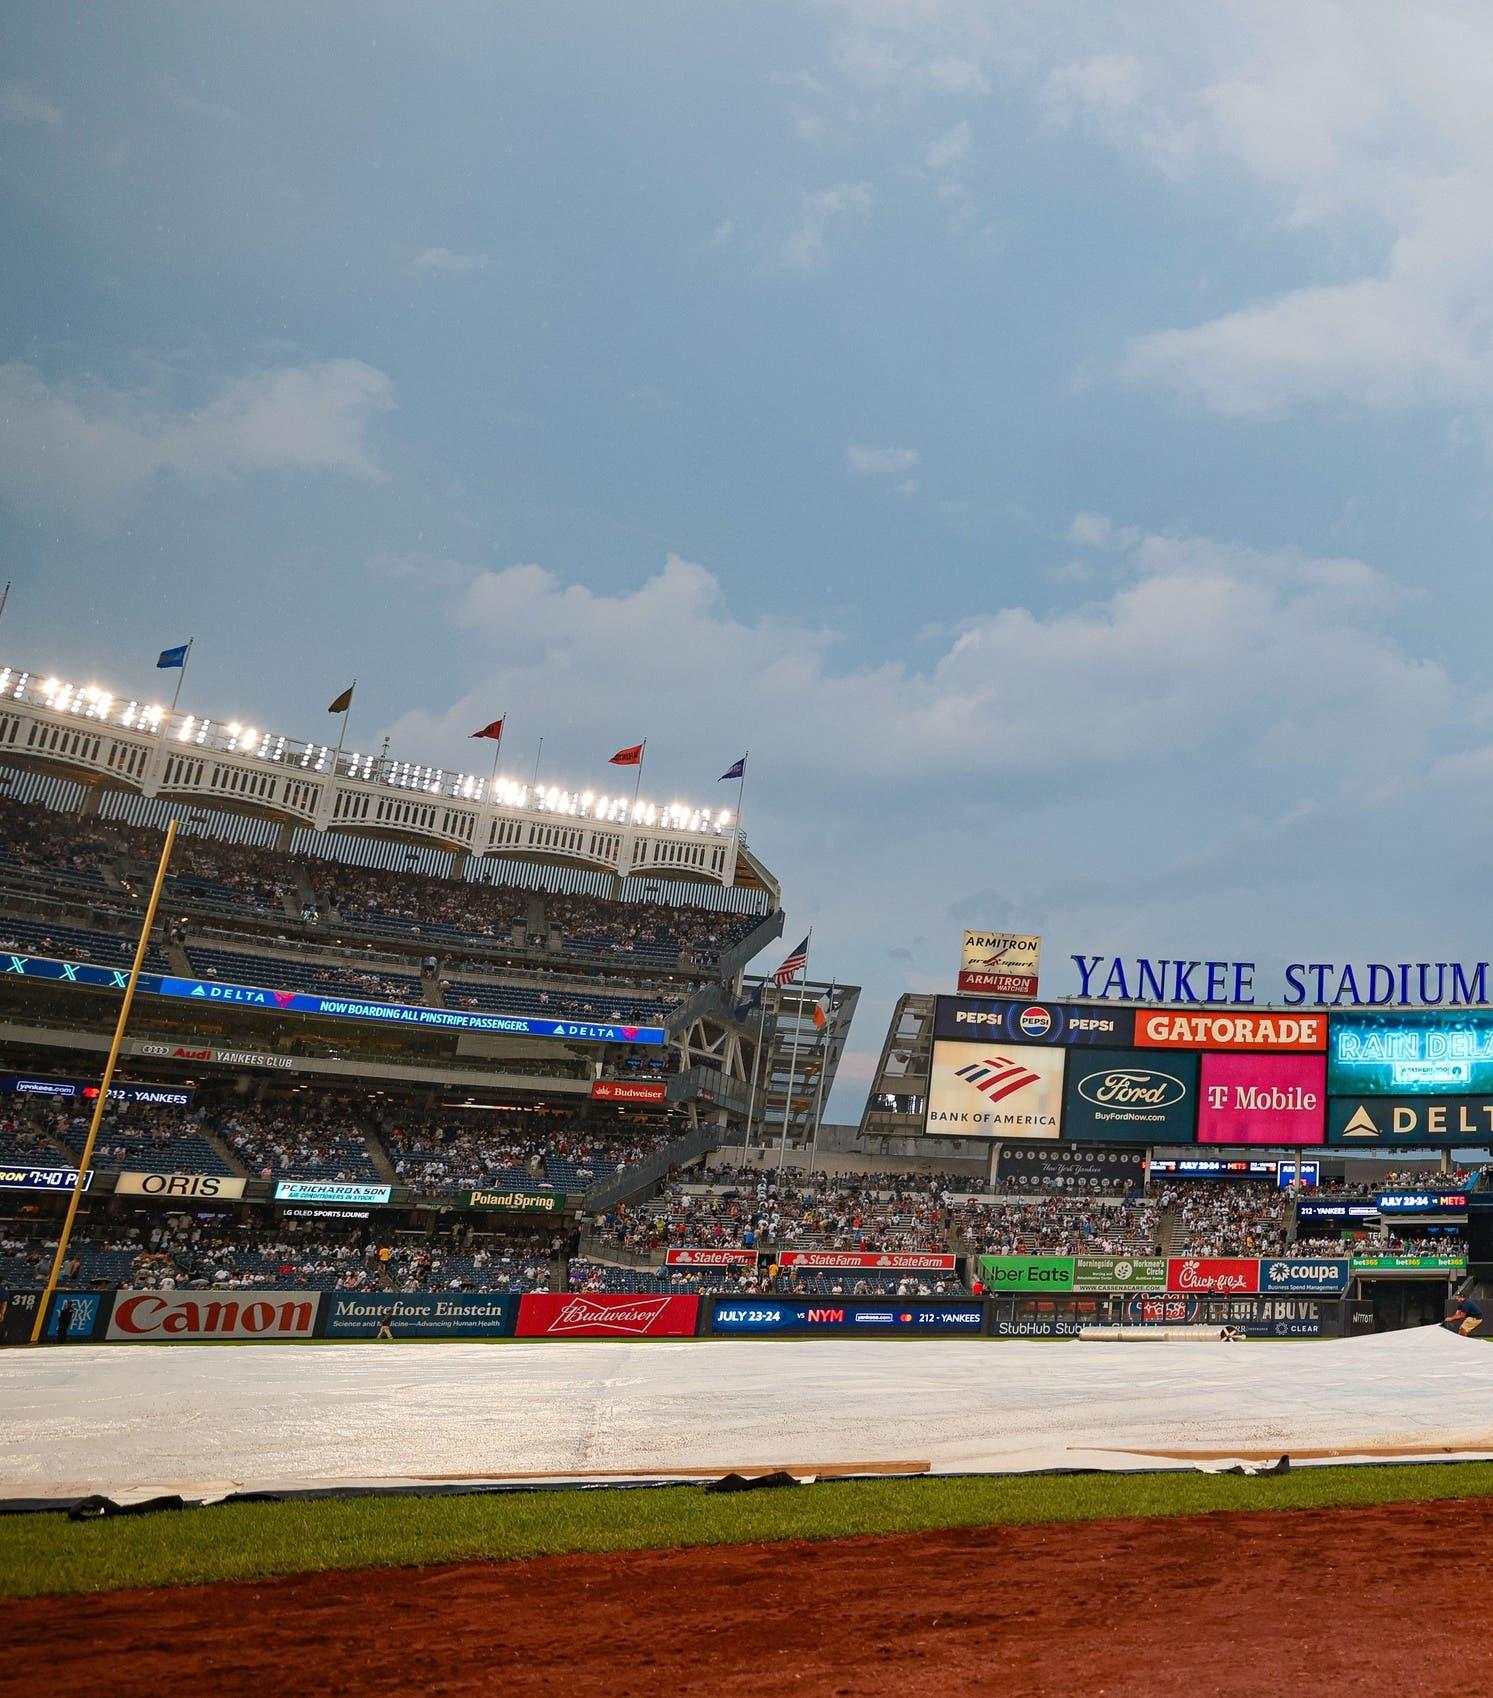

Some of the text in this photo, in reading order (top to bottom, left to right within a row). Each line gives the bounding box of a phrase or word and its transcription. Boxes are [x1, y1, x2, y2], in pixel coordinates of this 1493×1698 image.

[966, 936, 1037, 951] ARMITRON
[966, 974, 1031, 987] ARMITRON
[1070, 954, 1490, 1006] YANKEE STADIUM
[210, 987, 265, 1003] DELTA
[997, 984, 1029, 993] WATCHES
[319, 1001, 530, 1031] NOW BOARDING ALL PINSTRIPE PASSENGERS.
[956, 1011, 1114, 1032] PEPSI PEPSI PEPSI
[569, 1026, 615, 1038] DELTA
[1146, 1016, 1319, 1045] GATORADE
[1337, 1032, 1419, 1060] RAIN
[173, 1048, 293, 1068] Audi YANKEES CLUB
[19, 1083, 72, 1094] yankees.com
[614, 1087, 662, 1098] Budweiser
[1095, 1074, 1167, 1104] Ford
[135, 1092, 188, 1104] YANKEES
[1236, 1086, 1317, 1111] Mobile
[931, 1111, 1057, 1126] BANK OF AMERICA
[1095, 1112, 1166, 1122] BuyFordNow.com
[29, 1171, 63, 1185] 7:40
[142, 1175, 222, 1197] ORIS
[281, 1184, 386, 1196] PC RICHARD & SON
[300, 1192, 344, 1200] CONDITIONERS
[470, 1190, 555, 1210] Poland Spring
[1380, 1196, 1465, 1206] JULY METS
[293, 1209, 313, 1217] OLED
[313, 1210, 342, 1218] SPORTS
[342, 1211, 370, 1219] LOUNGE
[1316, 1207, 1345, 1215] YANKEES
[1027, 1266, 1069, 1282] Eats
[1146, 1268, 1163, 1276] Circle
[1179, 1265, 1247, 1289] Chick-fil-A
[1290, 1265, 1339, 1283] coupa
[1305, 1284, 1339, 1292] Management
[12, 1294, 36, 1306] 318
[115, 1294, 311, 1333] Canon
[335, 1300, 502, 1316] Montefiore Einstein
[562, 1304, 657, 1325] Budweiser
[717, 1308, 845, 1323] JULY 23-24 NYM
[333, 1320, 500, 1329] Science and Human Health
[919, 1313, 980, 1323] 212 YANKEES
[999, 1322, 1050, 1335] StubHub
